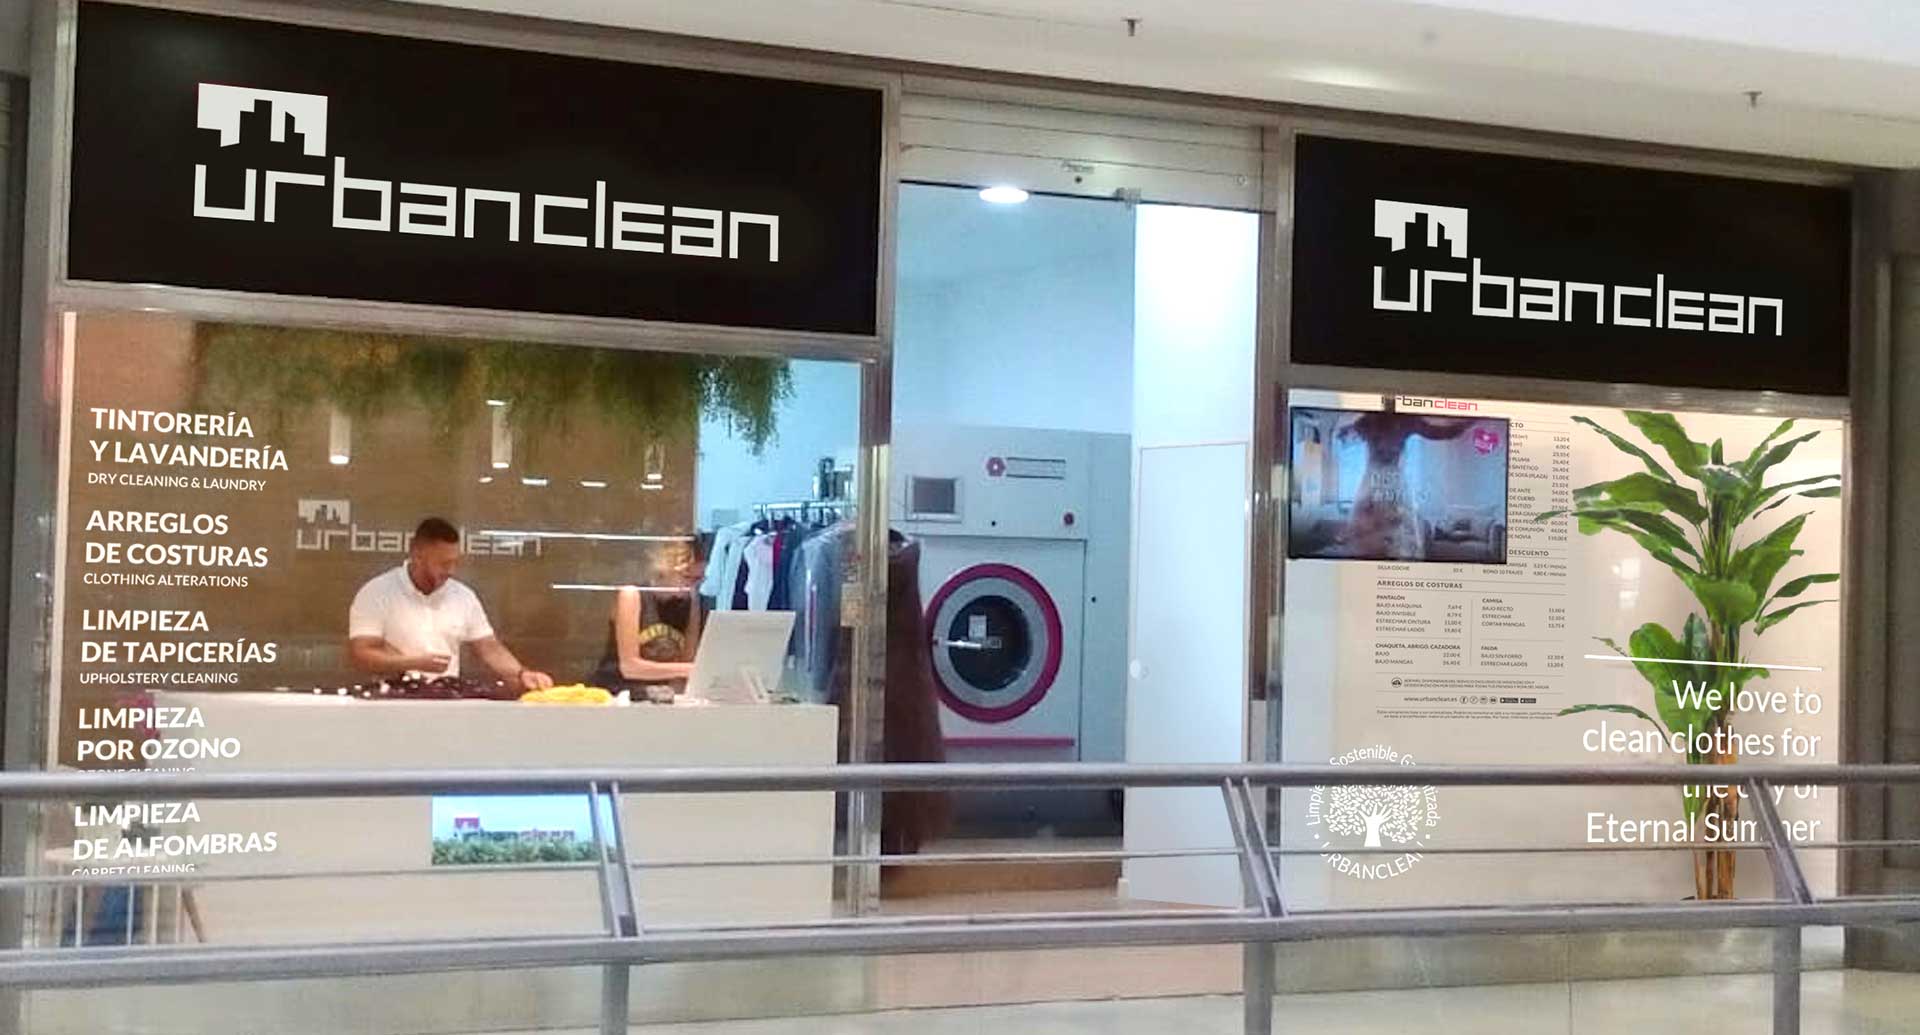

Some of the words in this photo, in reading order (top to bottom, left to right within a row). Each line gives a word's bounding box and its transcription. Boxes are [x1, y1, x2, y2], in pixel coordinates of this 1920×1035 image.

[194, 157, 780, 263] urbanclean
[1373, 257, 1783, 336] urbanclean
[90, 407, 254, 438] TINTORERÍA
[89, 439, 109, 462] Y
[114, 441, 289, 471] LAVANDERÍA
[87, 472, 117, 485] DRY
[119, 474, 189, 488] CLEANING
[191, 477, 201, 488] &
[203, 477, 266, 491] LAUNDRY
[85, 510, 229, 536] ARREGLOS
[85, 541, 121, 564] DE
[126, 544, 269, 568] COSTURAS
[1508, 549, 1550, 557] DESCUENTO
[83, 572, 155, 585] CLOTHING
[157, 574, 249, 588] ALTERATIONS
[82, 609, 209, 632] LIMPIEZA
[81, 641, 117, 663] DE
[123, 638, 278, 663] TAPICERÍAS
[79, 672, 170, 684] UPHOLSTERY
[171, 672, 239, 684] CLEANING
[1672, 680, 1723, 711] We
[1729, 681, 1787, 713] love
[1793, 686, 1822, 715] to
[78, 706, 206, 730] LIMPIEZA
[77, 738, 135, 761] POR
[140, 737, 241, 760] OZONO
[1582, 720, 1663, 753] clean
[1670, 724, 1775, 756] clothes
[1781, 728, 1822, 757] for
[1329, 744, 1398, 767] Sostenible
[74, 802, 201, 828] LIMPIEZA
[1586, 812, 1695, 843] Eternal
[73, 838, 108, 861] DE
[114, 832, 278, 859] ALFOMBRAS
